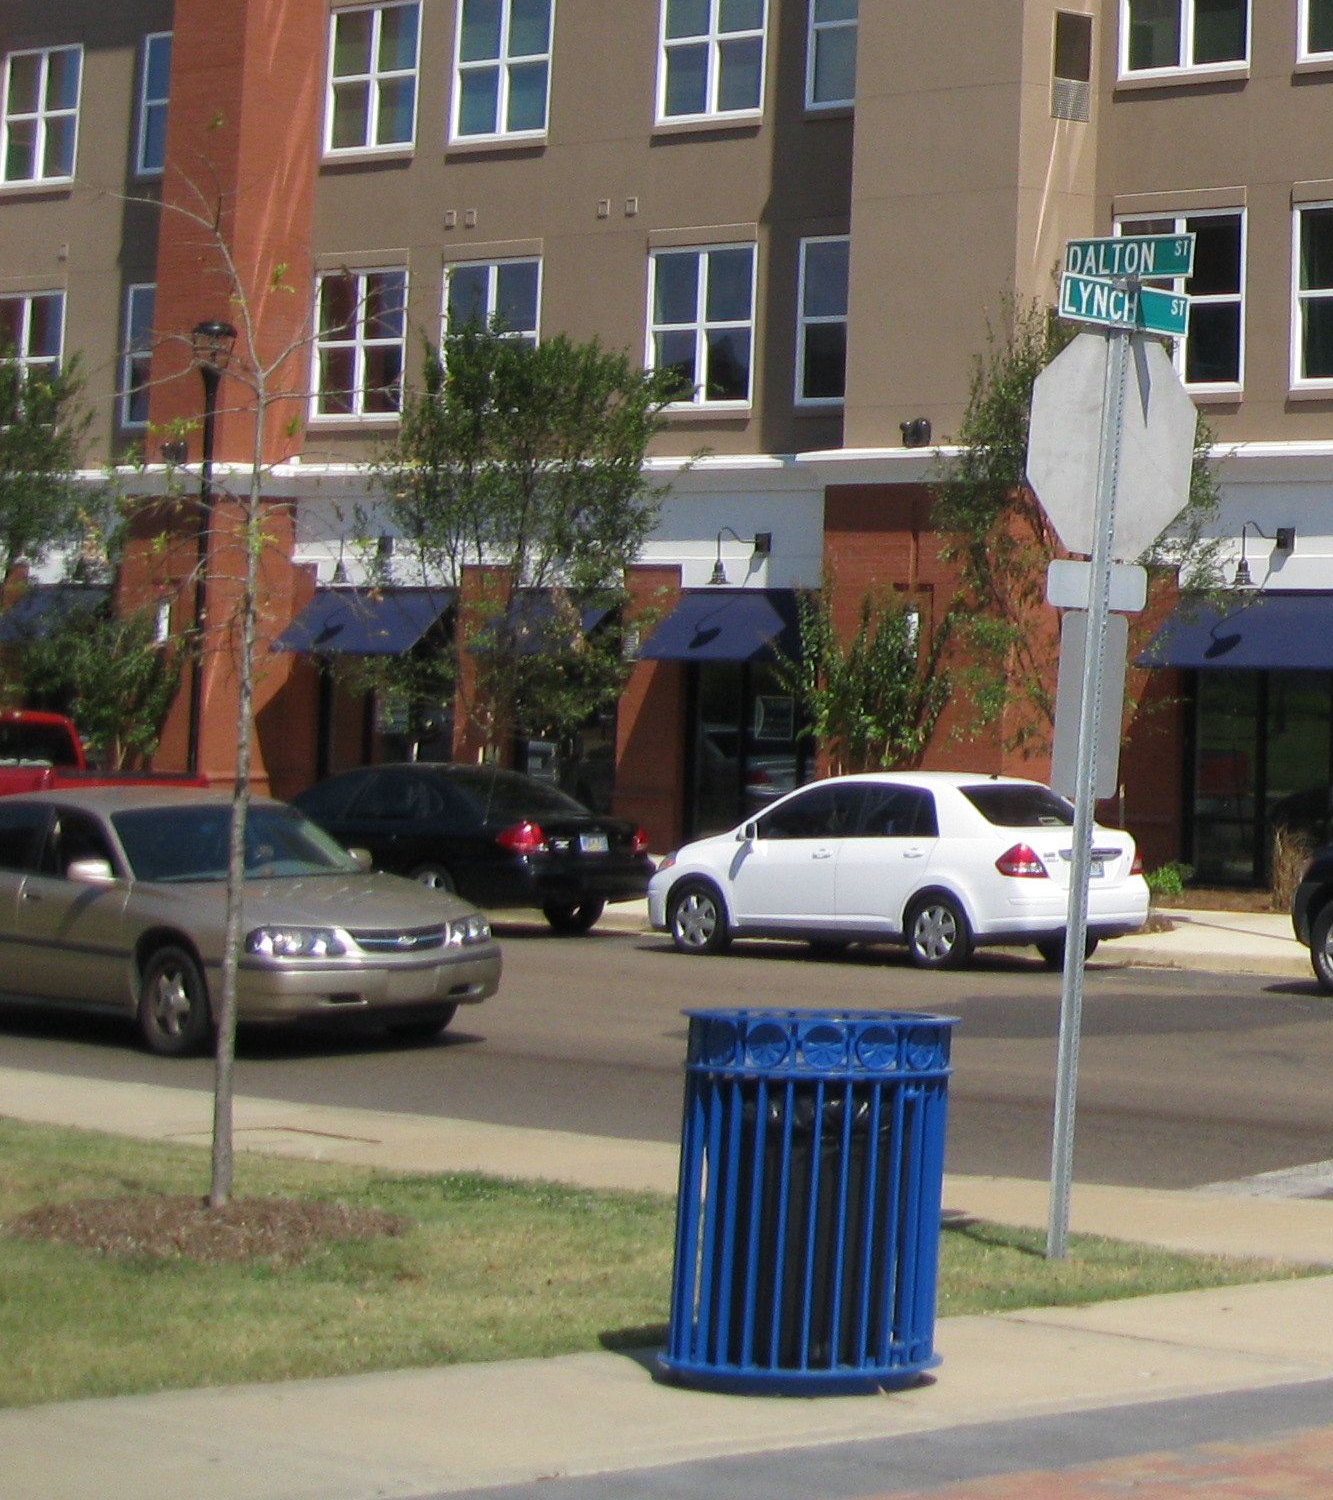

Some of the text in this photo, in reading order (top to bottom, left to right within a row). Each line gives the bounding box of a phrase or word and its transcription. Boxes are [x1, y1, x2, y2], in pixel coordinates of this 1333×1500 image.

[1068, 239, 1189, 275] DALTON ST
[1064, 279, 1186, 322] LYNCH ST
